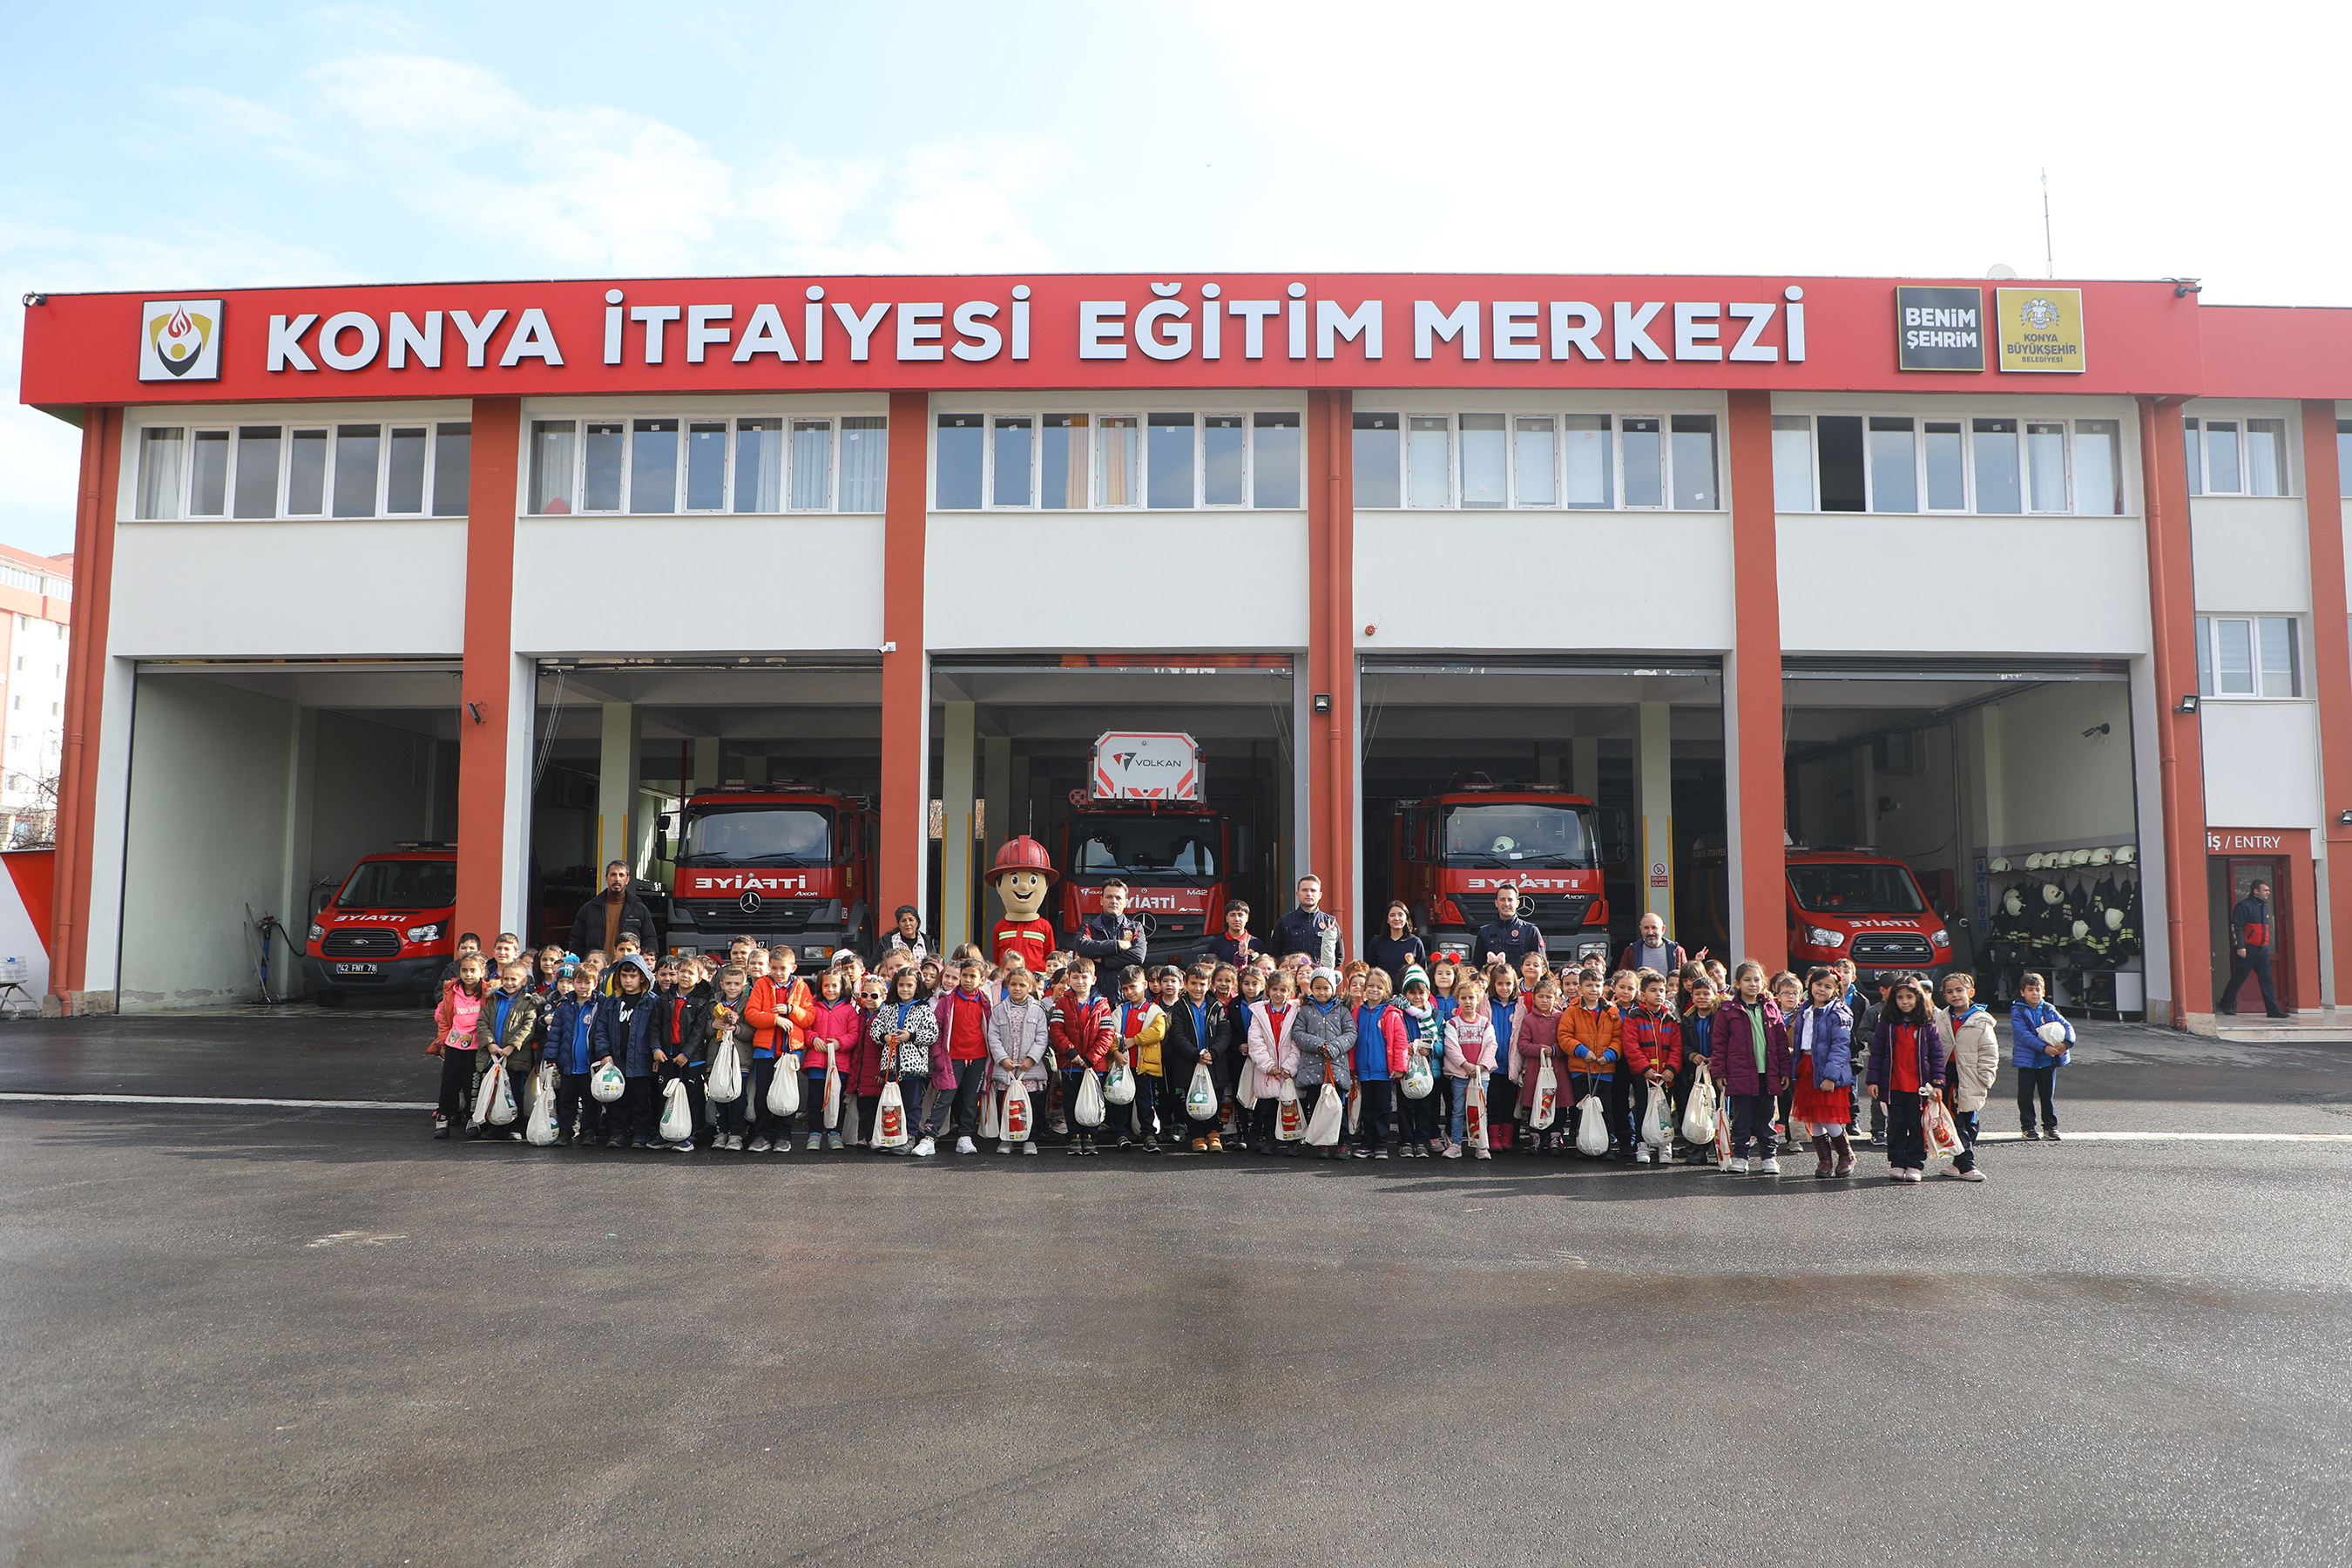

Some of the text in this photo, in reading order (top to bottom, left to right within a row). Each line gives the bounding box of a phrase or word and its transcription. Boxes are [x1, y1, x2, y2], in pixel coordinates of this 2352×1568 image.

[1905, 308, 1976, 328] BENİM
[267, 282, 1806, 371] KONYA İTFAİYESİ EĞİTİM MERKEZİ
[1906, 330, 1977, 349] ŞEHRİM
[2024, 334, 2058, 342] KONYA
[2007, 342, 2077, 355] BÜYÜKŞEHİR
[1135, 759, 1182, 767] VOLKAN
[2225, 835, 2231, 849] /
[2234, 835, 2281, 848] ENTRY
